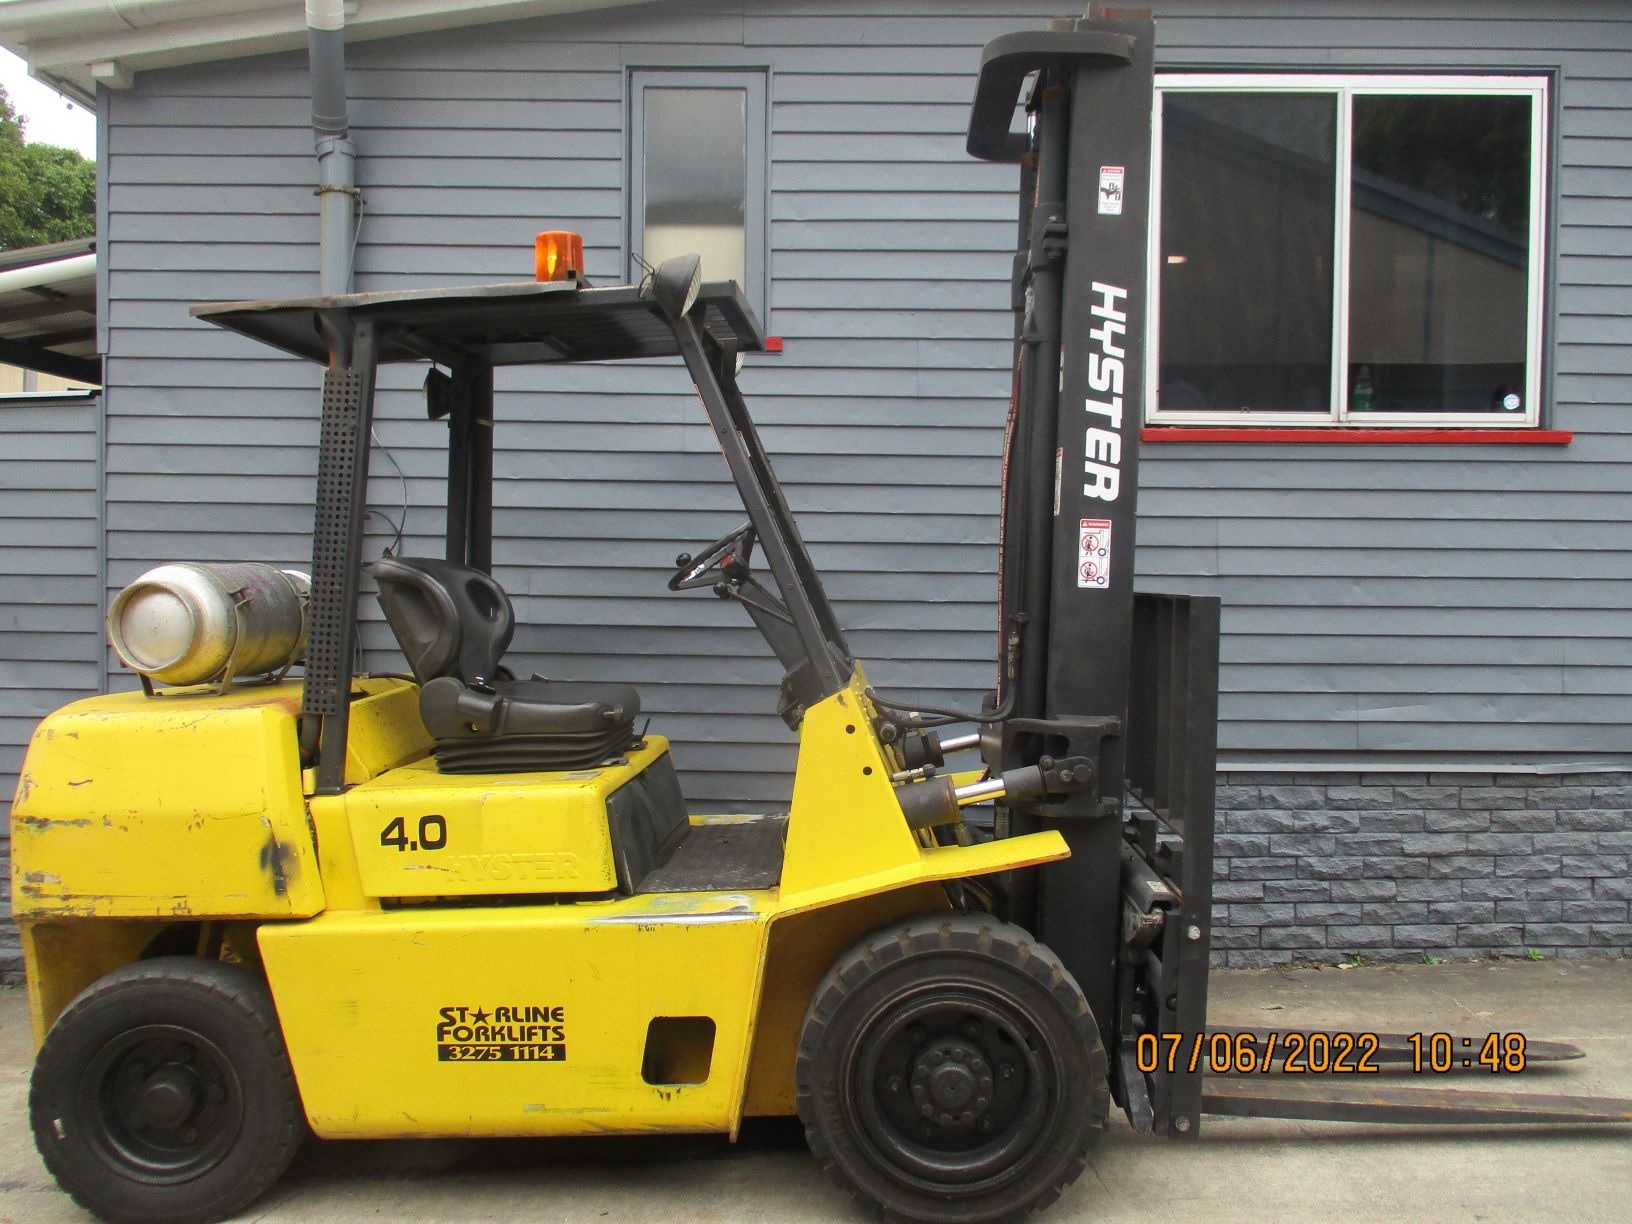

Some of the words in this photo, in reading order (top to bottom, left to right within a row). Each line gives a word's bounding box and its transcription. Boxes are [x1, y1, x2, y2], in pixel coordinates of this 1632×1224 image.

[1083, 281, 1128, 503] HYSTER
[380, 814, 447, 851] 4.0
[447, 852, 578, 881] HYSTER
[437, 1022, 566, 1042] FORKLIFTS
[449, 1046, 502, 1060] 3275
[510, 1046, 555, 1060] 1114
